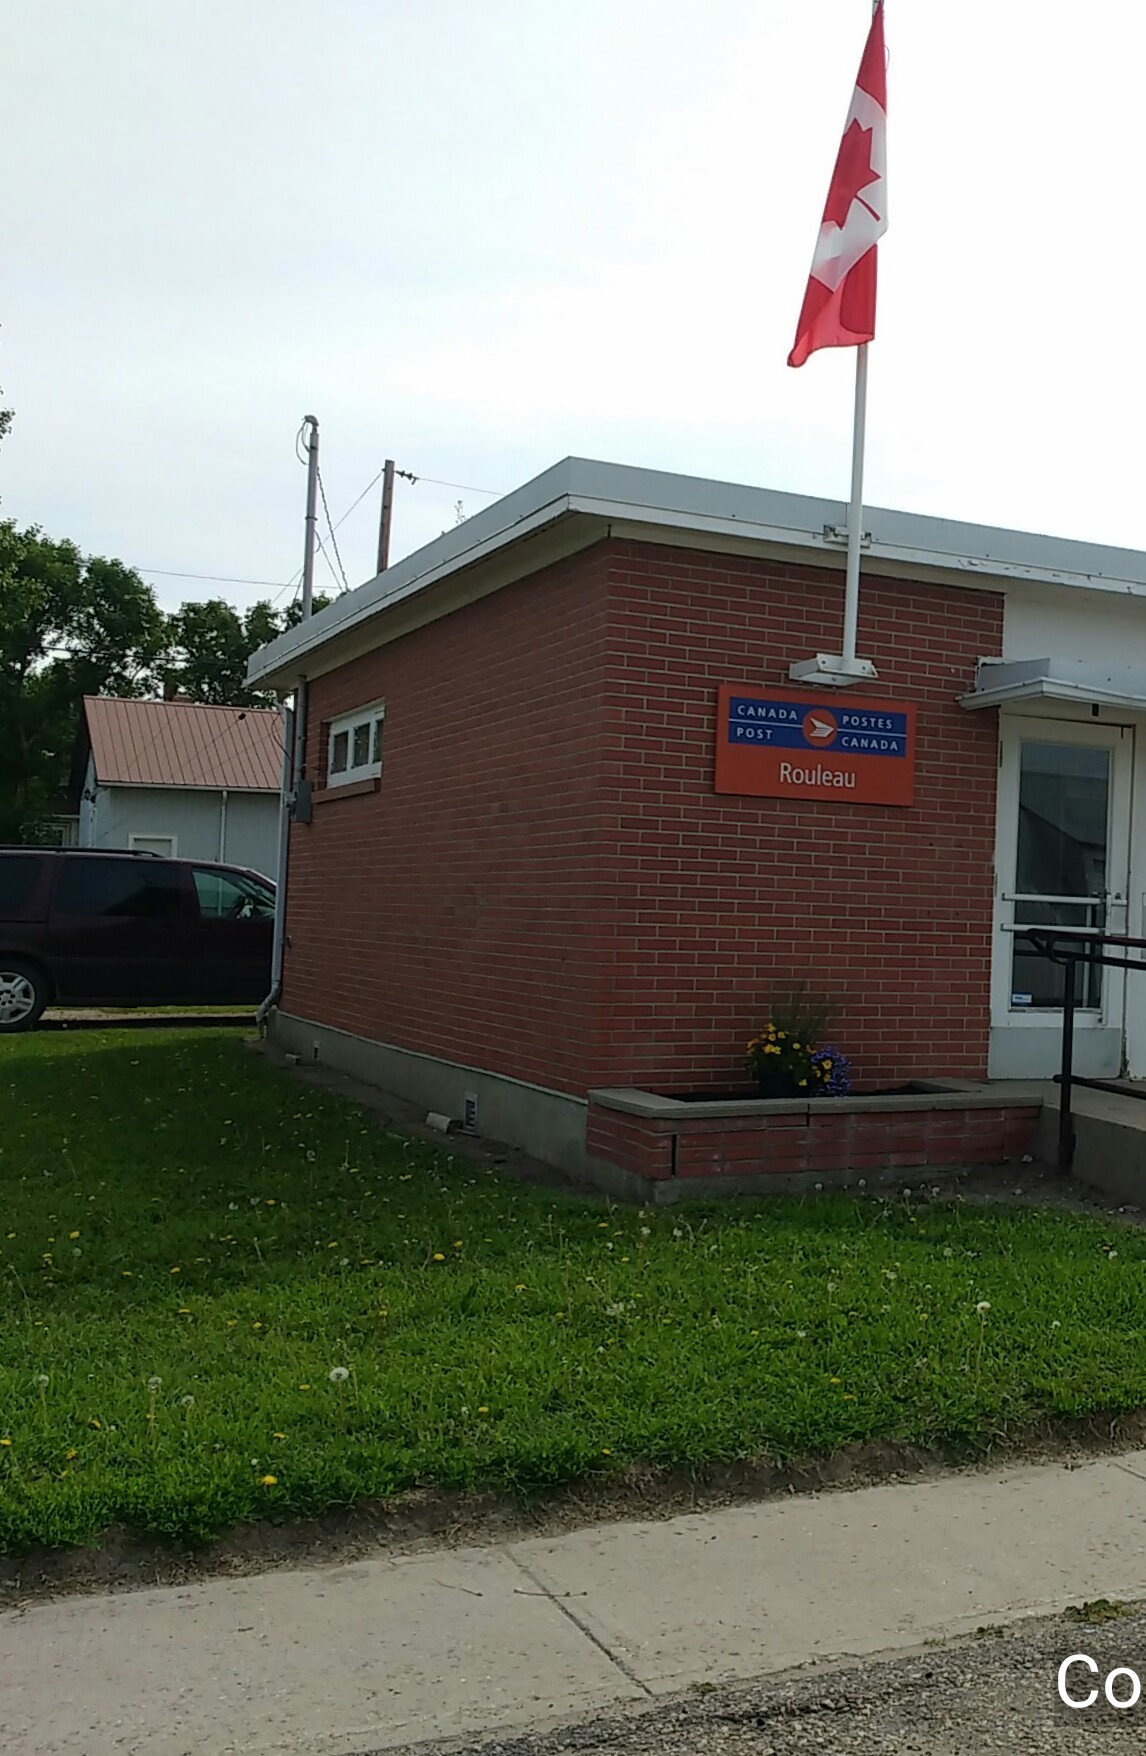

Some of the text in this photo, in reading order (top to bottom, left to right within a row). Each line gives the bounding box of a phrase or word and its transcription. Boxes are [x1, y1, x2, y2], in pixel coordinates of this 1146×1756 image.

[737, 705, 798, 720] CANADA
[842, 715, 893, 729] POSTES
[736, 727, 773, 740] POST
[841, 736, 898, 751] CANADA
[779, 762, 856, 788] Rouleau
